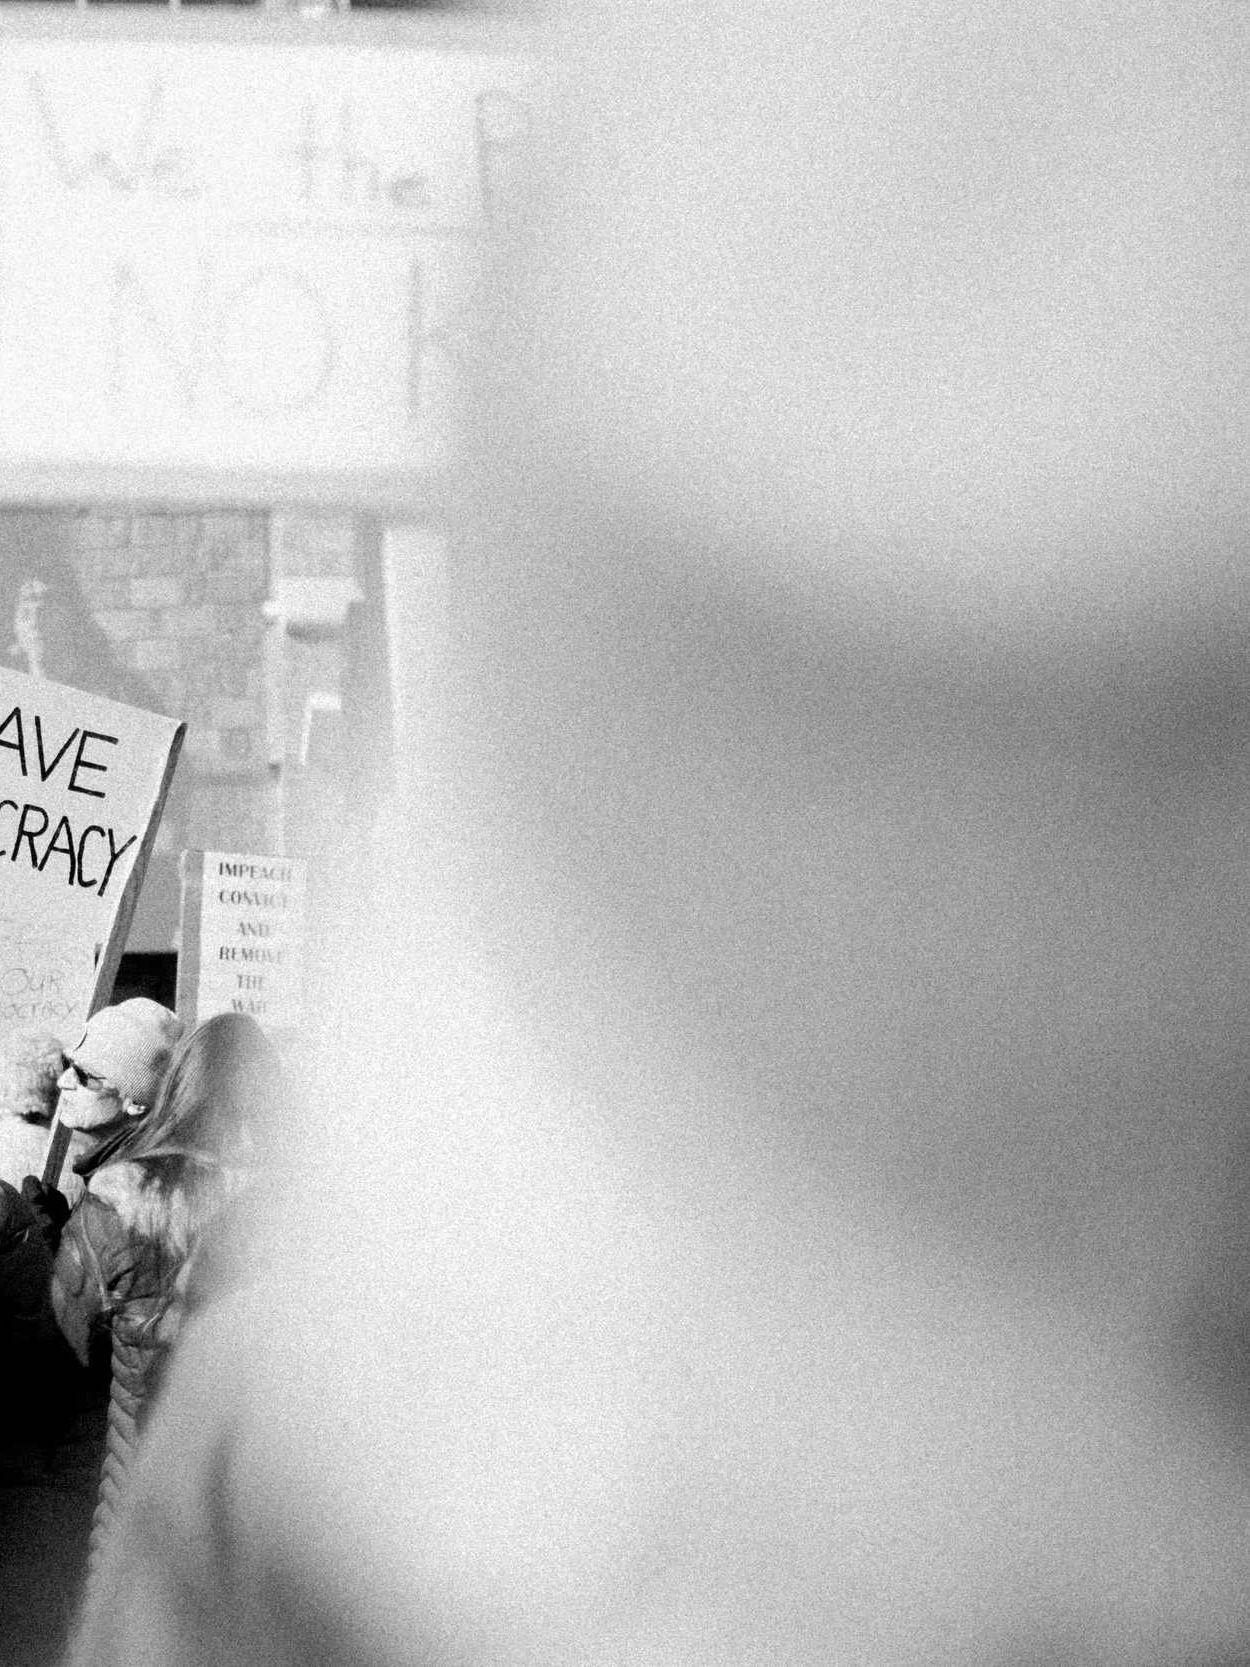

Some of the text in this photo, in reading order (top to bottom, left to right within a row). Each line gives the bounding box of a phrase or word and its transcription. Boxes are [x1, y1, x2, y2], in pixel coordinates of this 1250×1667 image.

[27, 71, 202, 197] We
[280, 101, 432, 209] the
[218, 862, 293, 882] IMPEACH
[218, 890, 290, 908] CONVICT
[237, 921, 271, 938] AND
[218, 946, 285, 965] REMOVE
[236, 974, 267, 991] THE
